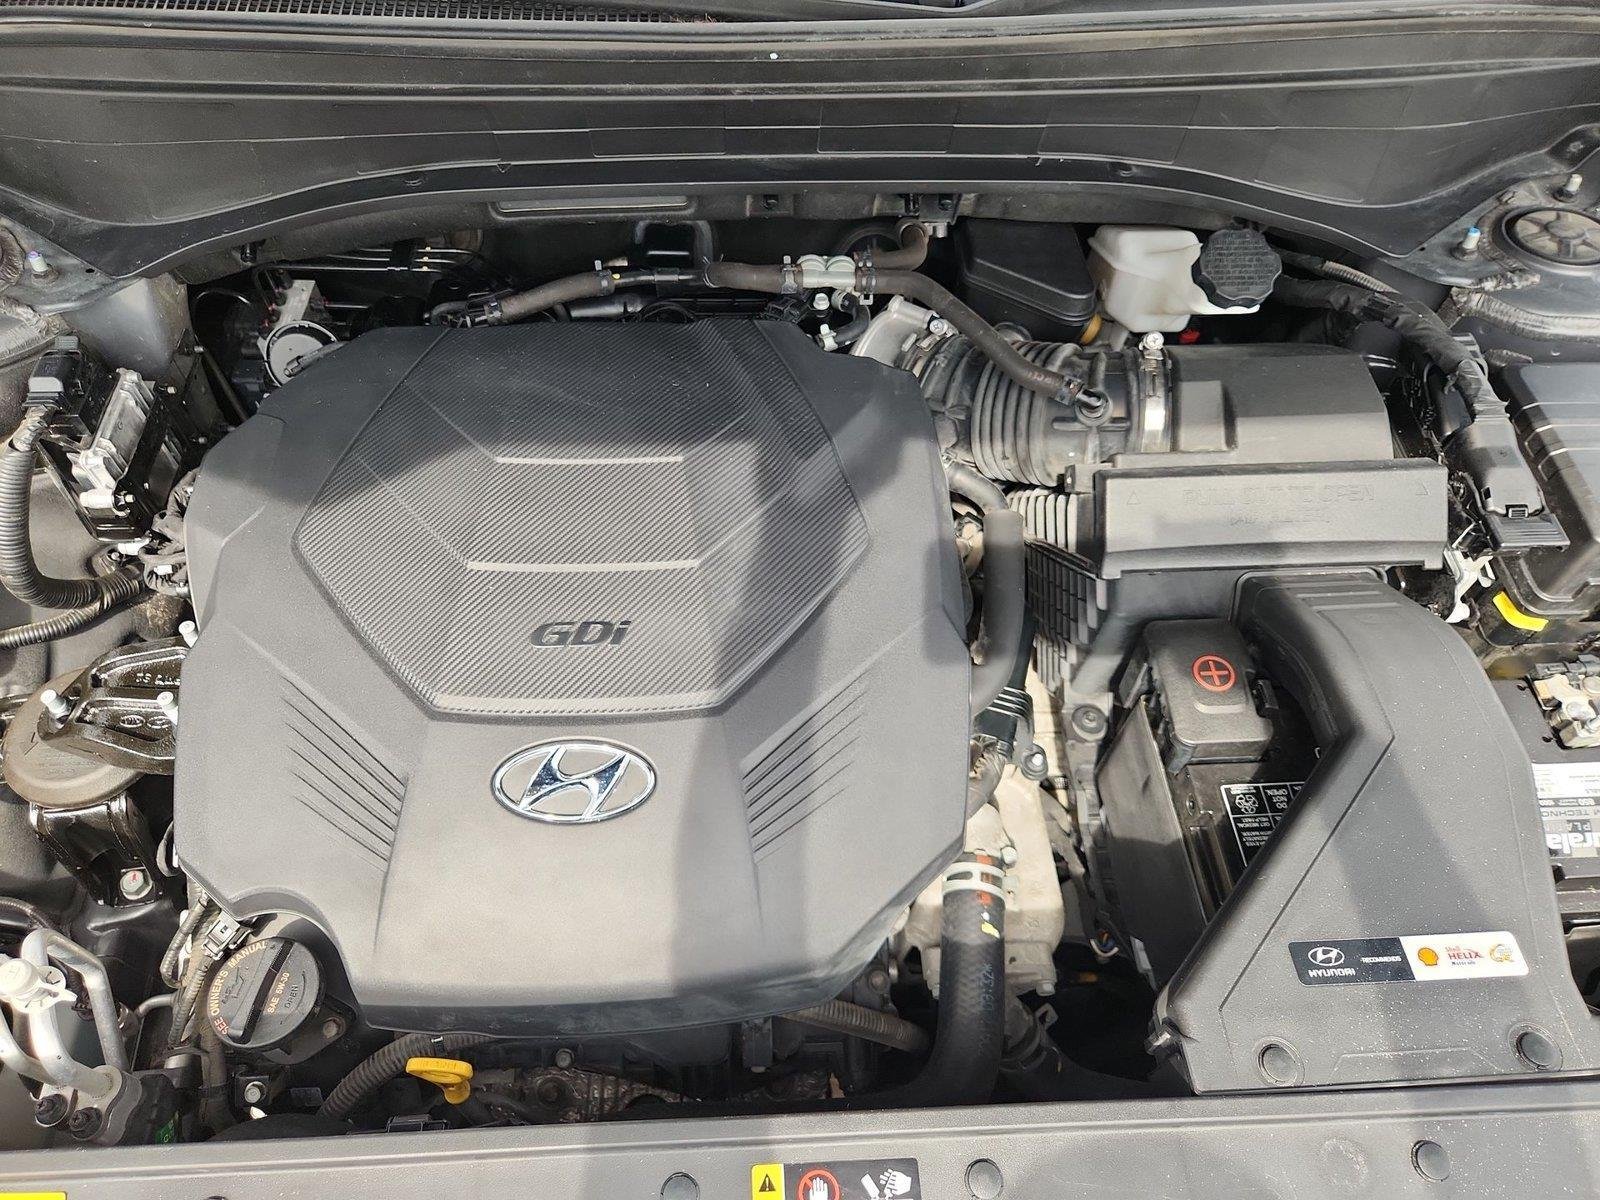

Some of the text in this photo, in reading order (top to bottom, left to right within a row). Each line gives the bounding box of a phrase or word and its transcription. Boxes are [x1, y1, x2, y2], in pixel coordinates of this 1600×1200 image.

[1183, 489, 1235, 505] PULL
[1323, 484, 1375, 502] OPEN
[530, 620, 632, 647] GDi
[227, 941, 267, 968] MANUAL
[1448, 952, 1481, 960] HELIX
[1308, 967, 1356, 978] HYUNDAI
[210, 970, 229, 1016] OWNER'S
[267, 972, 290, 1013] SAE 5W-30
[284, 984, 299, 1009] OPEN
[214, 1016, 229, 1035] SEE
